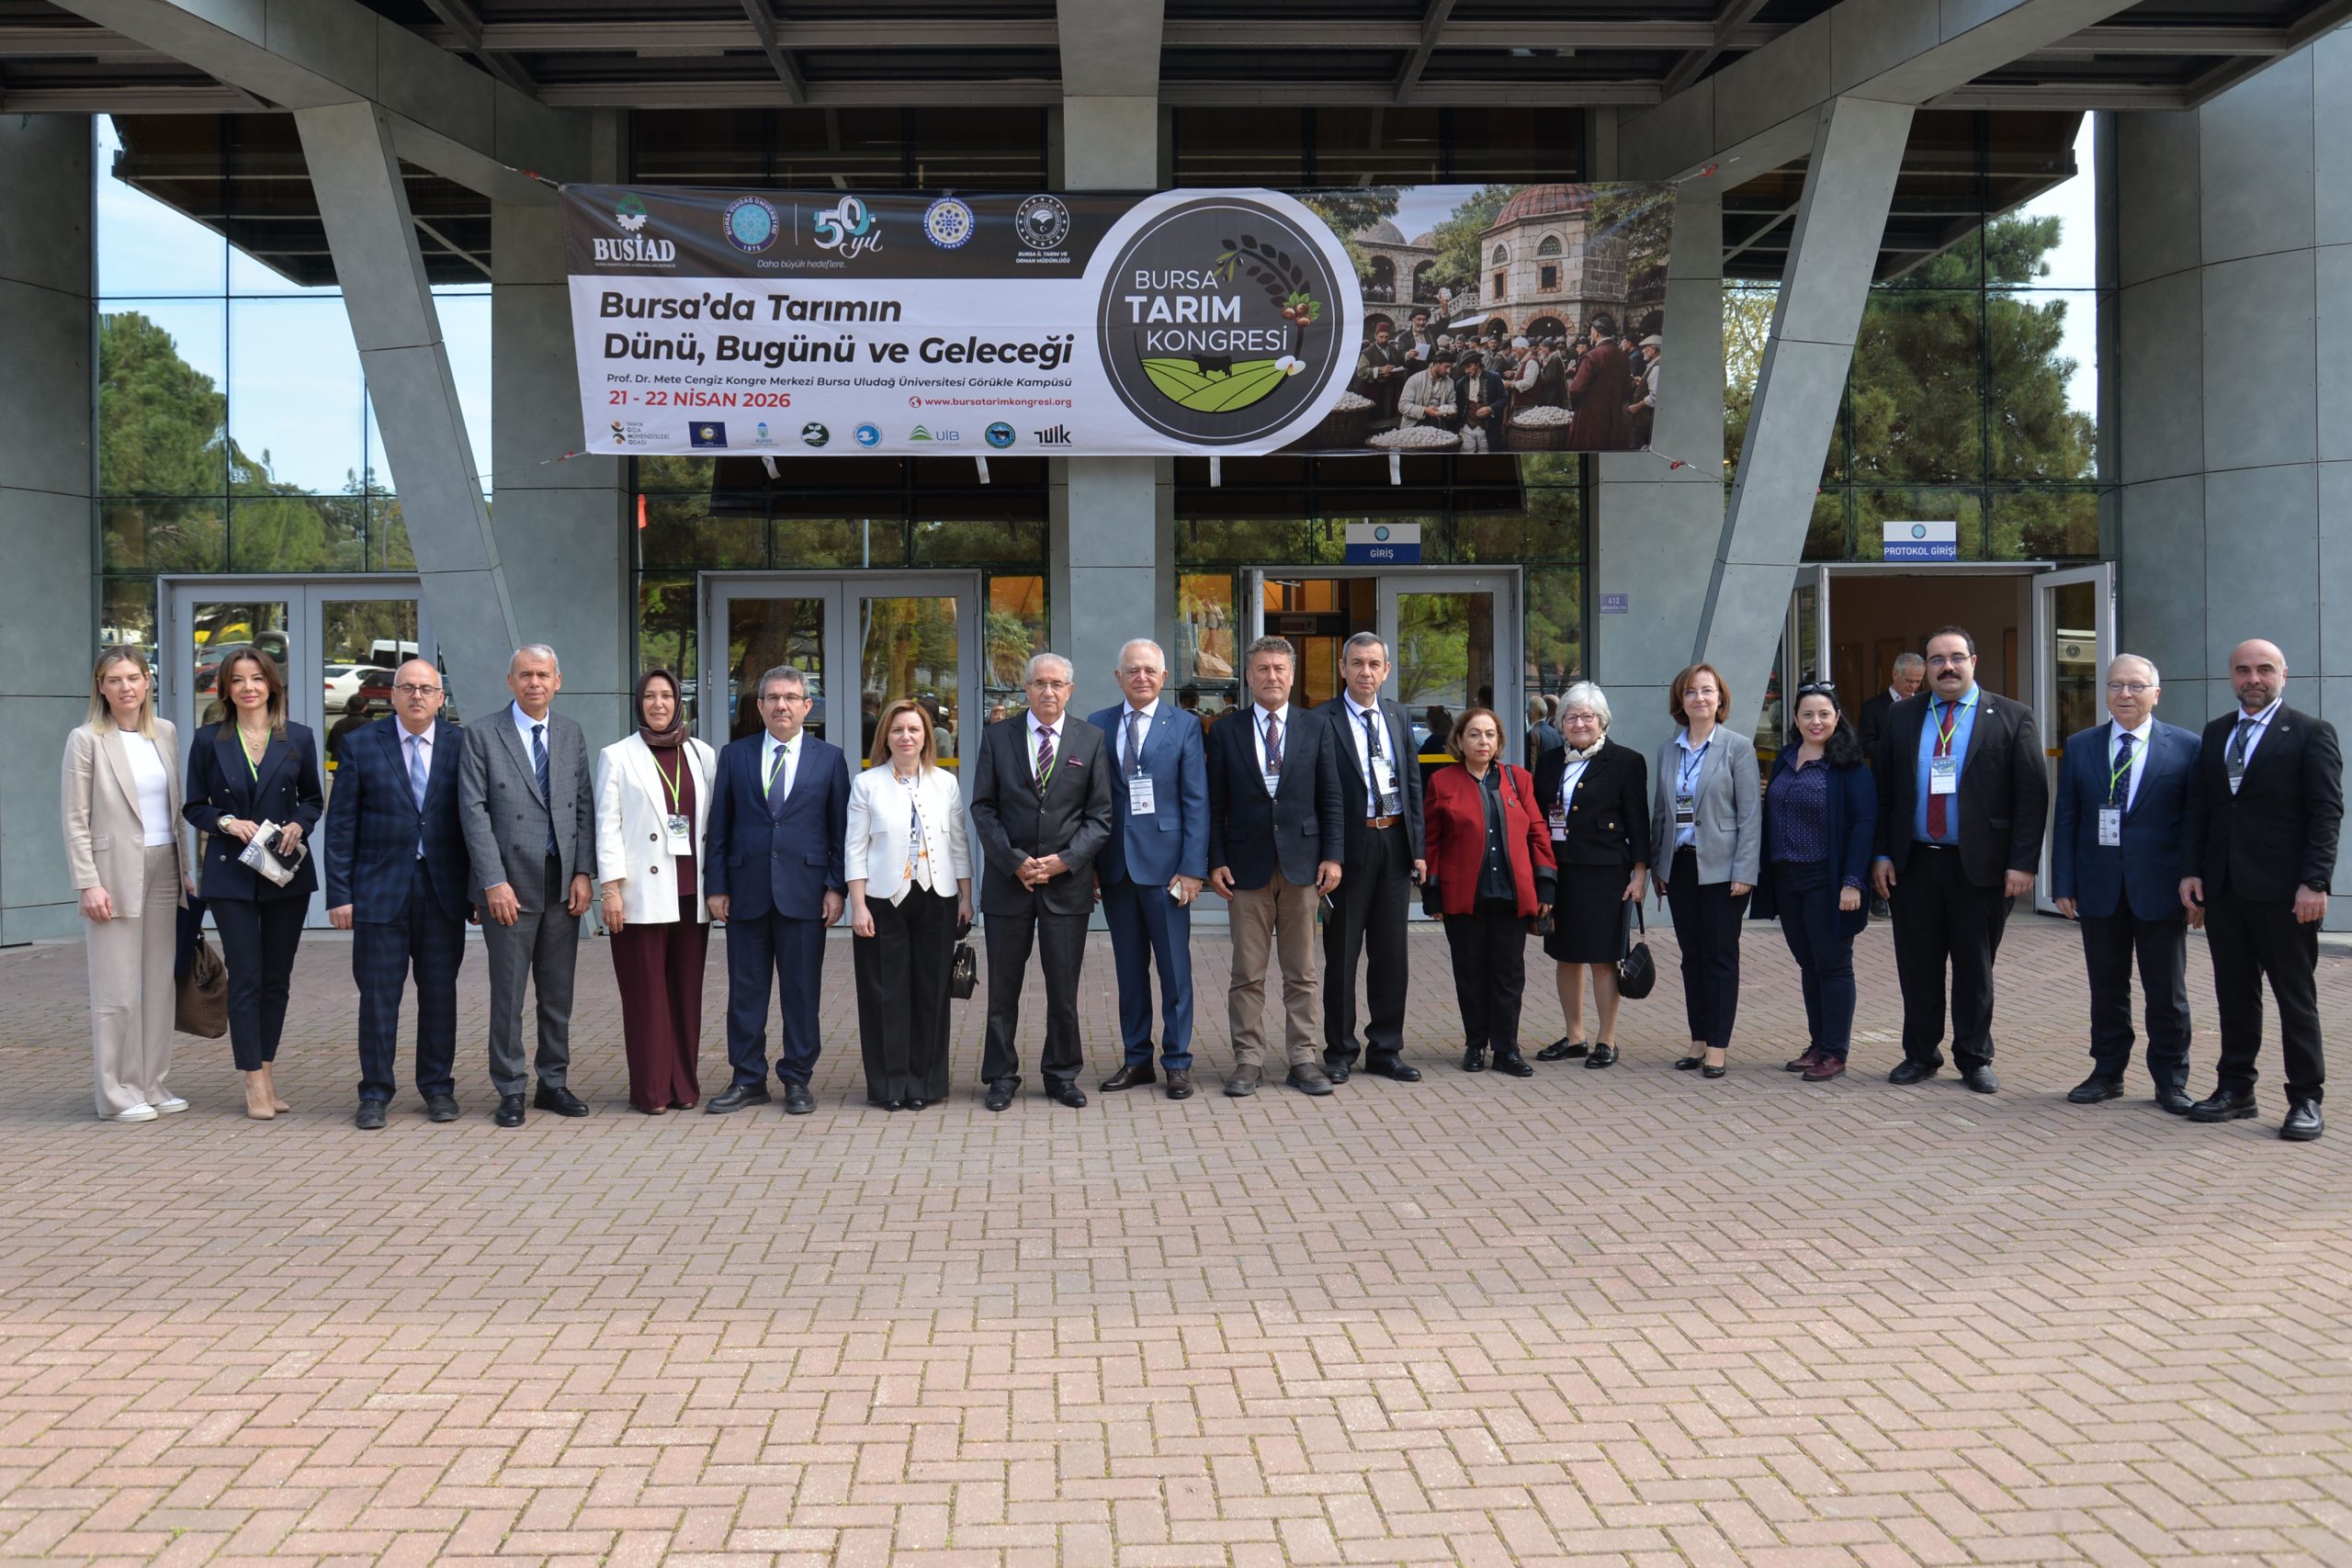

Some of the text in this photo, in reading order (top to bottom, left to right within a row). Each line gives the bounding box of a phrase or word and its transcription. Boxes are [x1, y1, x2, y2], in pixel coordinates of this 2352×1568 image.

[593, 233, 676, 262] BUSİAD
[757, 259, 779, 268] Daha
[780, 259, 806, 270] büyük
[1136, 270, 1218, 289] BURSA
[600, 291, 902, 322] Bursa'da Tarımın
[1125, 295, 1241, 323] TARIM
[1147, 325, 1287, 351] KONGRESİ
[604, 332, 1075, 371] Dünü, Bugünü ve Geleceği
[606, 373, 1073, 389] Prof. Dr. Mete Cengiz Kongre Merkezi Bursa Uludağ Üniversitesi Görükle Kampüsü
[609, 390, 628, 405] 21
[645, 391, 668, 406] 22
[673, 388, 738, 407] NİSAN
[742, 392, 791, 408] 2026
[924, 398, 1072, 408] www.bursatarimkongresi.org
[1370, 547, 1394, 559] GİRİŞ
[1883, 545, 1956, 557] PROTOKOL GİRİŞİ
